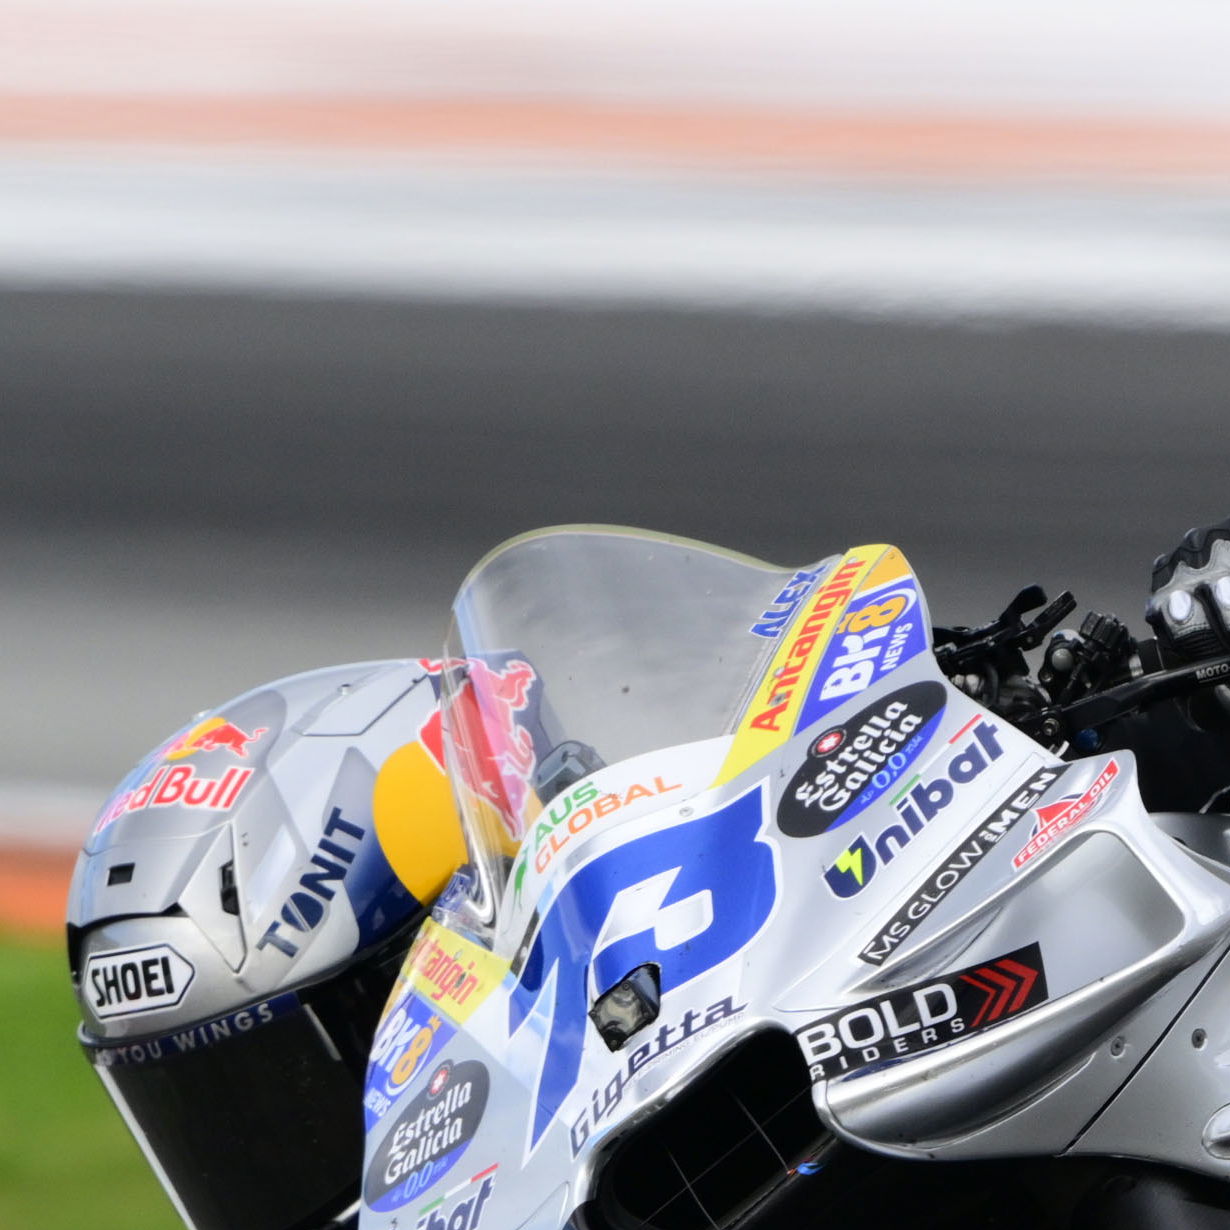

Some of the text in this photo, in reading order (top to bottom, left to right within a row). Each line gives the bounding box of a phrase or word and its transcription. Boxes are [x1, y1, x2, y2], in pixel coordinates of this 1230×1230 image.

[750, 560, 866, 732] Antangin
[879, 622, 913, 672] NEWS
[148, 764, 255, 812] Bull
[794, 700, 908, 808] Estrella
[818, 713, 923, 812] Galicia
[533, 780, 601, 848] AUS
[534, 775, 683, 875] GLOBAL
[822, 720, 1000, 899] Unibat
[1016, 769, 1118, 864] FEDERAL OIL
[863, 921, 911, 961] MS
[907, 840, 984, 920] GLOW
[990, 772, 1058, 832] MEN
[91, 955, 175, 1008] SHOEI
[115, 1041, 162, 1064] YOU
[173, 1002, 274, 1052] WINGS
[797, 982, 960, 1067] BOLD
[808, 1016, 966, 1081] RIDERS
[387, 1080, 473, 1156] Estrella
[570, 995, 749, 1158] Gigetta
[384, 1116, 464, 1186] Galicia
